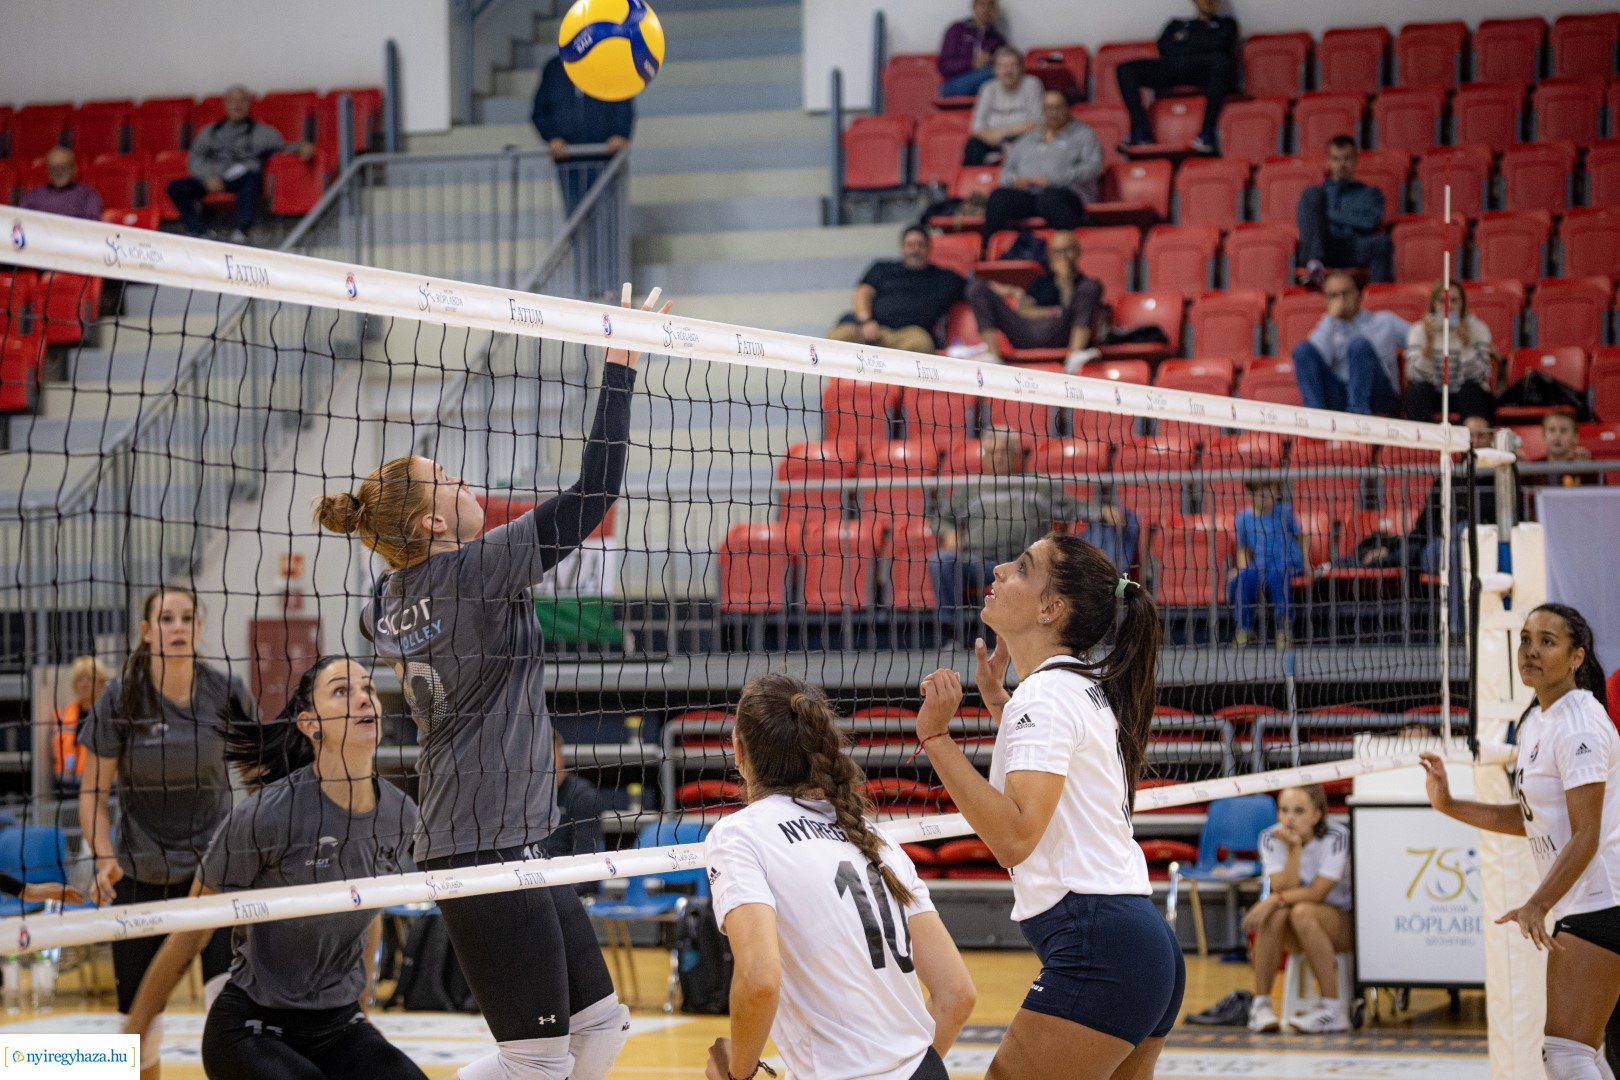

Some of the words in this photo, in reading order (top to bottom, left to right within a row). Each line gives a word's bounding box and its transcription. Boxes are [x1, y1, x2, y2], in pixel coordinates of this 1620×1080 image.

[224, 254, 270, 286] FATUM
[508, 298, 544, 325] FATUM
[736, 333, 765, 357] FATUM
[513, 868, 547, 887] FATUM
[231, 898, 270, 920] FATUM
[834, 860, 915, 974] 10
